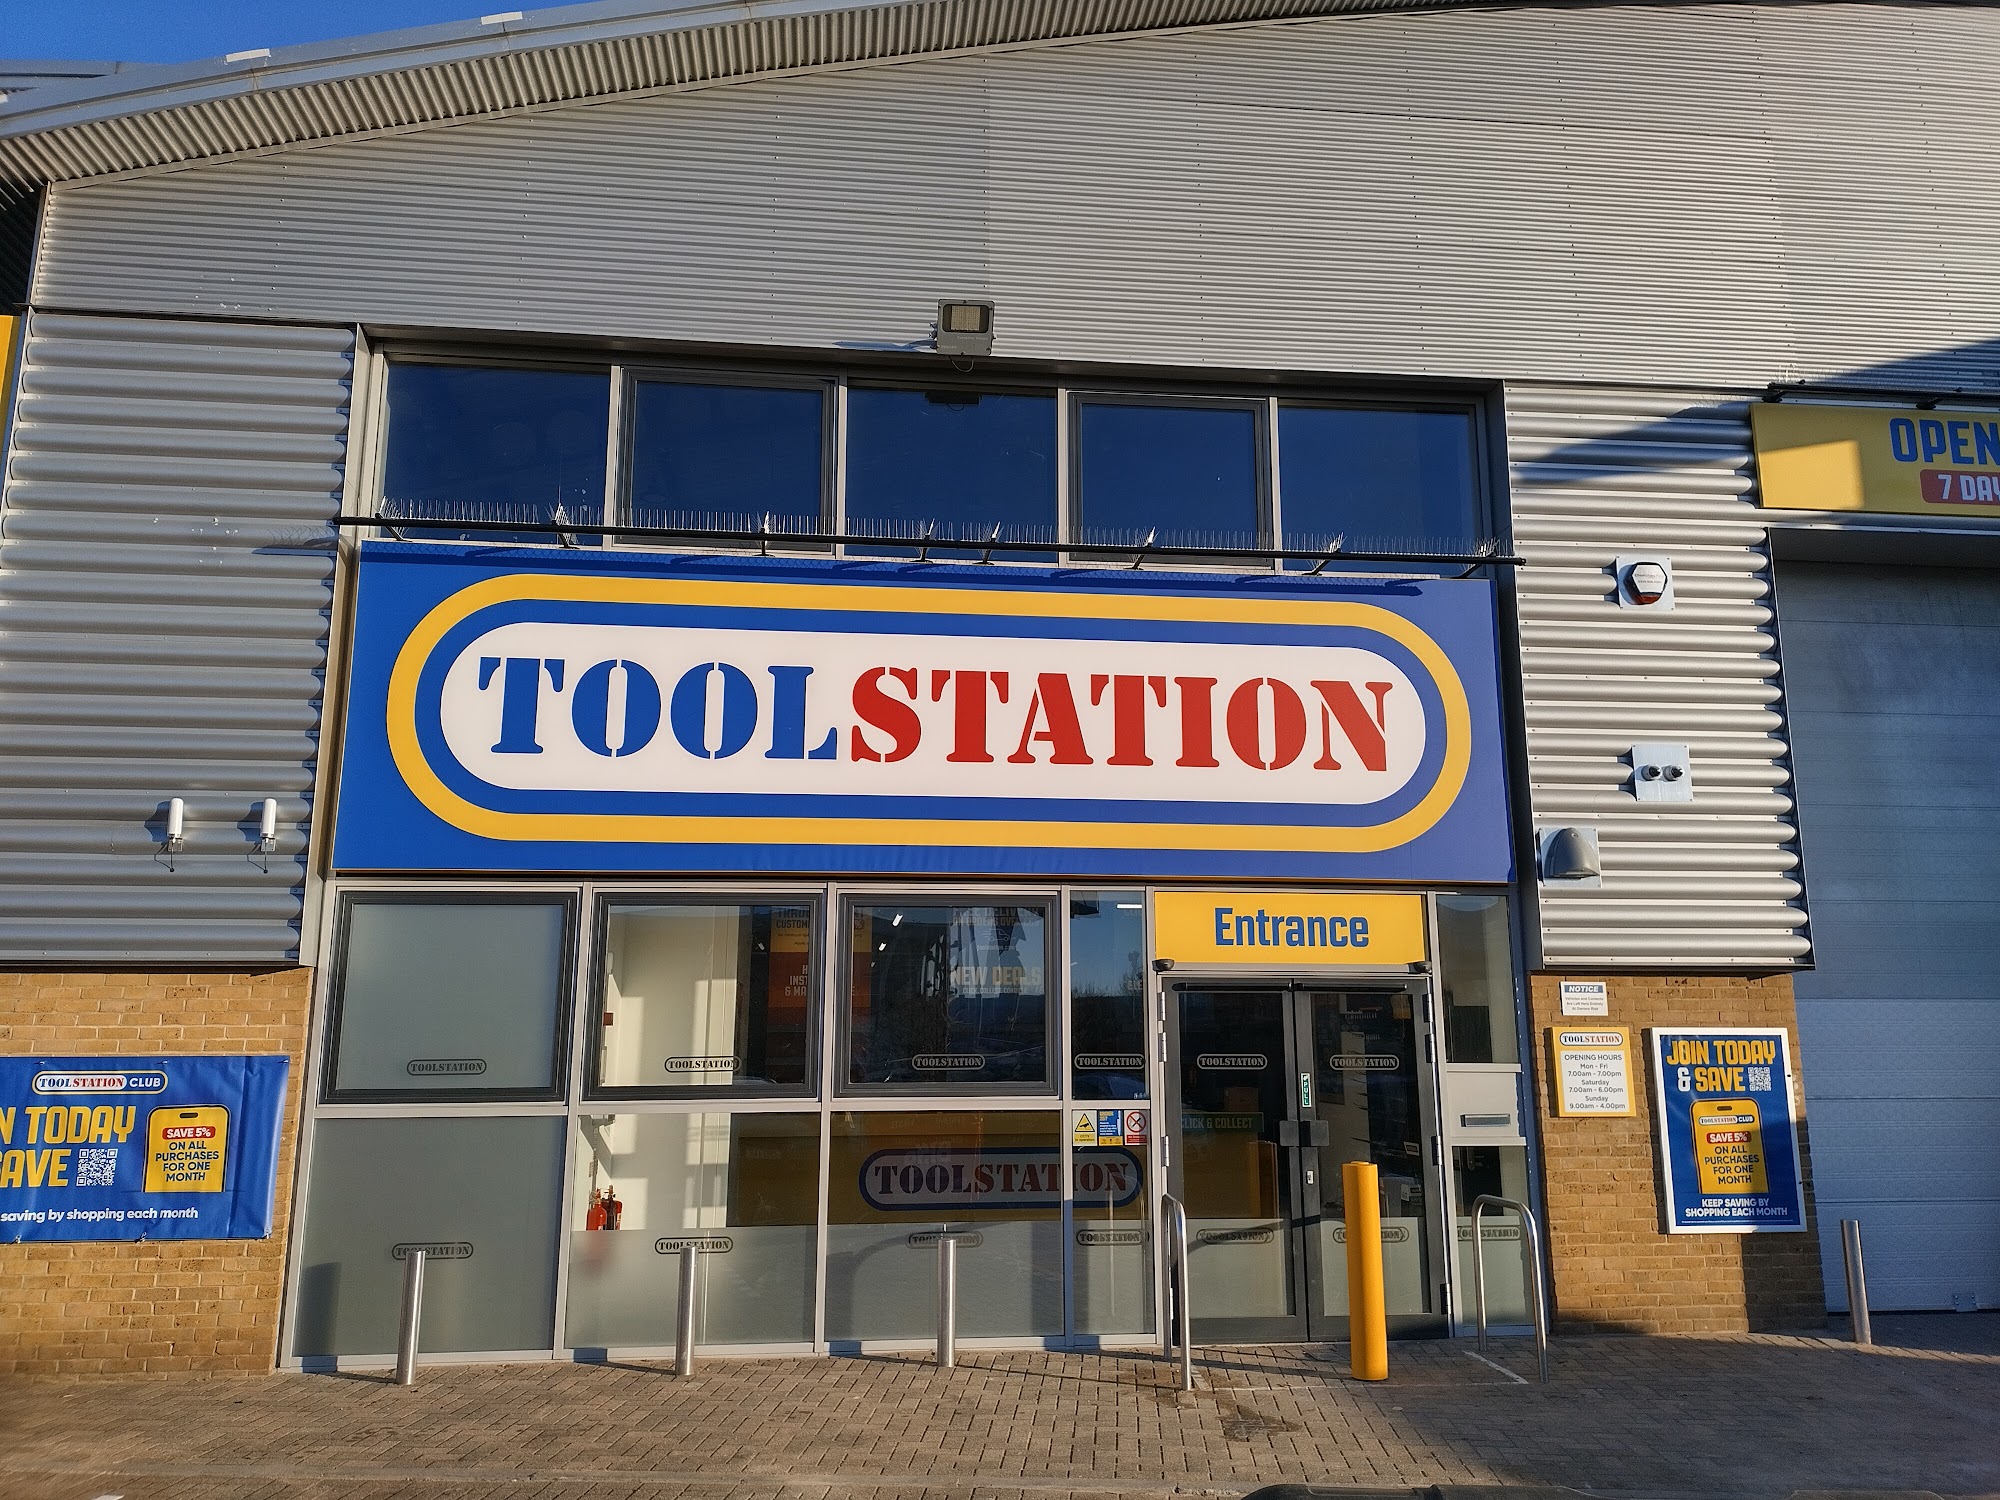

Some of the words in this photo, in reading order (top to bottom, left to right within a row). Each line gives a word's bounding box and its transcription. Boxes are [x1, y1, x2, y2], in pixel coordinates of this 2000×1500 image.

[1889, 417, 2000, 466] OPEN
[1937, 474, 1952, 500] 7
[478, 656, 1392, 771] TOOLSTATION
[1214, 907, 1369, 947] Entrance
[950, 966, 988, 985] NEW
[992, 966, 1041, 985] DEALS
[1568, 985, 1599, 993] NOTICE
[1562, 1035, 1620, 1043] TOOLSTATION
[1666, 1040, 1710, 1066] JOIN
[1713, 1040, 1776, 1065] TODAY
[915, 1057, 982, 1067] TOOLSTATION
[1077, 1057, 1143, 1066] TOOLSTATION
[1199, 1057, 1264, 1066] TOOLSTATION
[1332, 1058, 1396, 1067] TOOLSTATION
[411, 1062, 483, 1073] TOOLSTATION
[39, 1077, 125, 1088] TOOLSTATION
[129, 1077, 161, 1088] CLUB
[1677, 1066, 1691, 1092] &
[1694, 1066, 1746, 1092] SAVE
[24, 1105, 137, 1145] TODAY
[1214, 1117, 1254, 1129] COLLECT
[1700, 1117, 1737, 1125] TOOLSTATION
[166, 1128, 194, 1138] SAVE
[195, 1127, 211, 1137] 5%
[1709, 1132, 1733, 1143] SAVE
[168, 1141, 186, 1151] ON
[188, 1140, 207, 1150] ALL
[1714, 1146, 1728, 1154] ON
[1731, 1145, 1747, 1154] ALL
[155, 1150, 219, 1162] PURCHASES
[1704, 1154, 1760, 1165] PURCHASES
[0, 1148, 72, 1188] AVE
[163, 1162, 185, 1172] FOR
[187, 1161, 211, 1171] ONE
[1713, 1166, 1732, 1175] FOR
[1734, 1165, 1754, 1174] ONE
[165, 1171, 206, 1183] MONTH
[1717, 1175, 1752, 1185] MONTH
[1701, 1198, 1724, 1208] KEEP
[1725, 1198, 1757, 1208] SAVING
[1759, 1198, 1769, 1207] BY
[0, 1209, 45, 1223] saving
[48, 1208, 65, 1222] by
[66, 1207, 125, 1223] shopping
[127, 1208, 157, 1220] each
[159, 1207, 199, 1219] month
[1685, 1208, 1731, 1217] SHOPPING
[1732, 1207, 1755, 1217] EACH
[1756, 1207, 1788, 1216] MONTH
